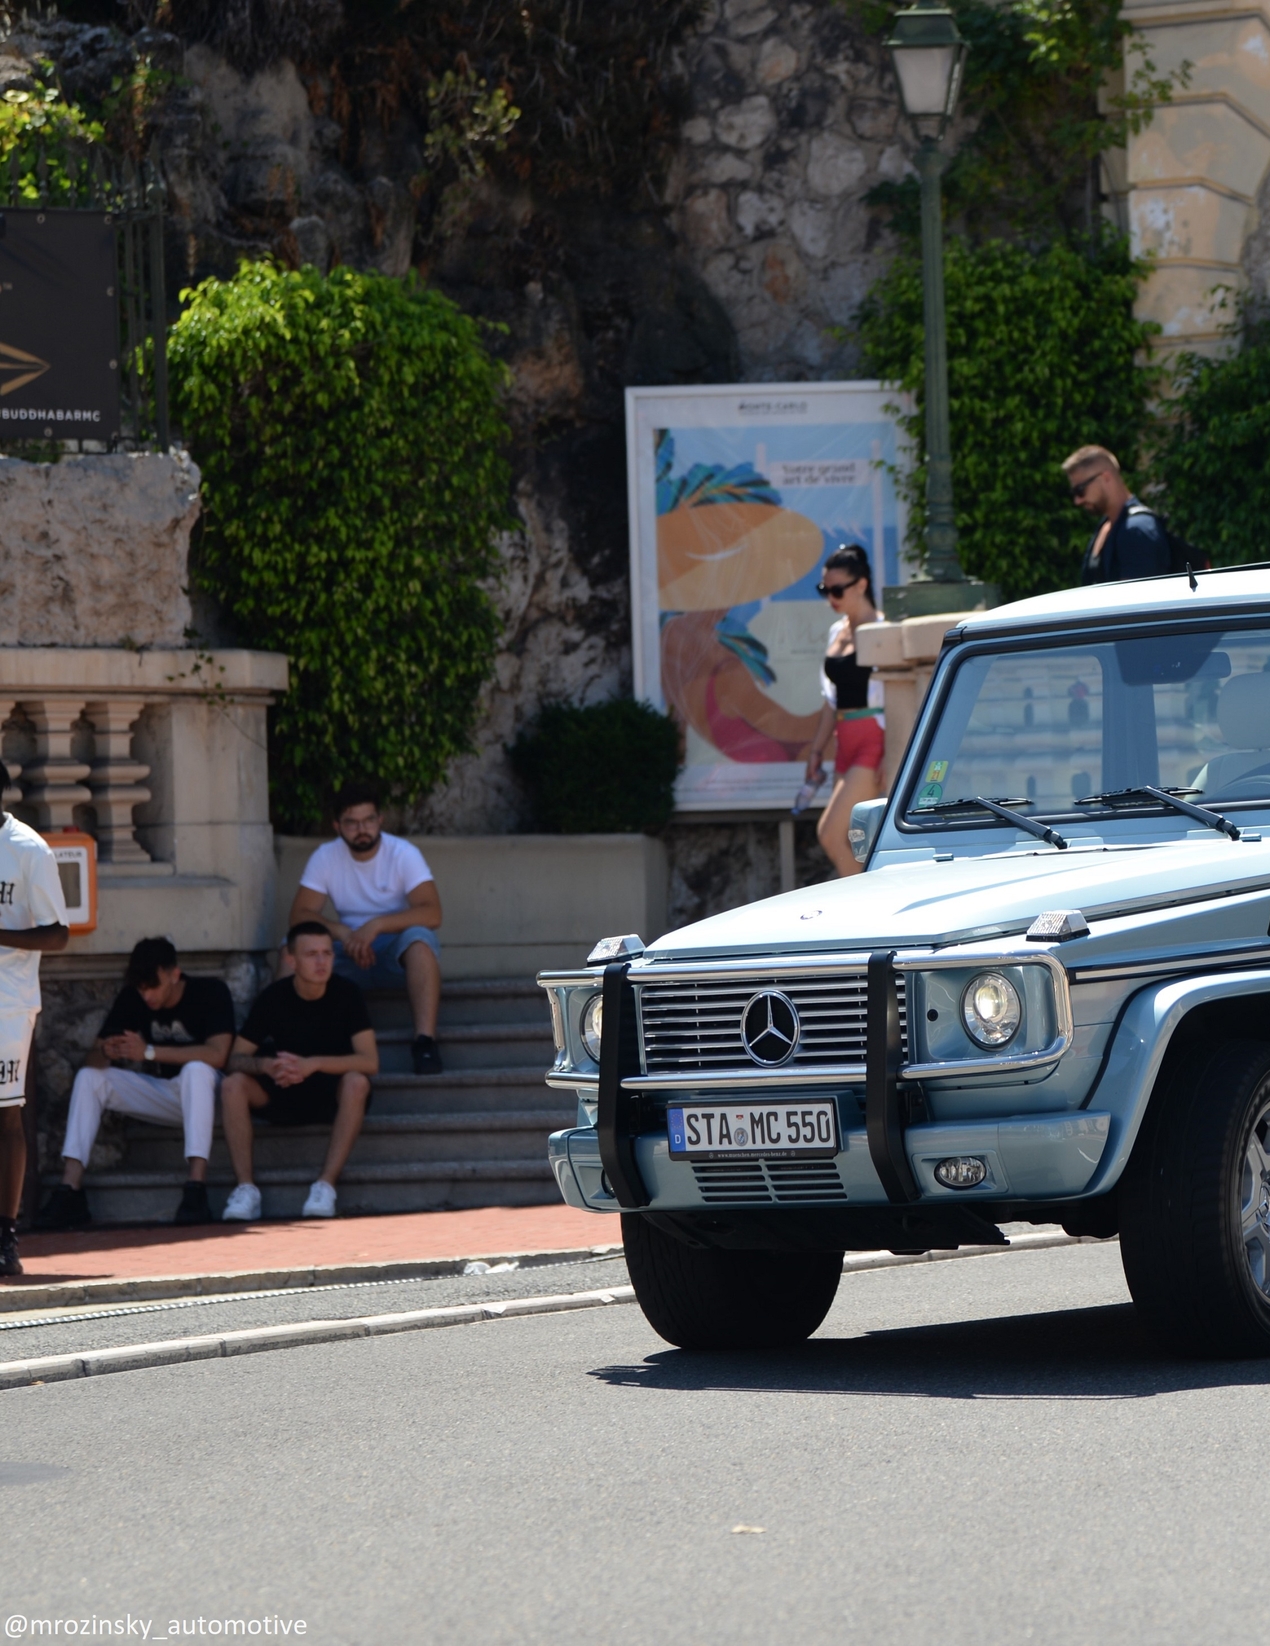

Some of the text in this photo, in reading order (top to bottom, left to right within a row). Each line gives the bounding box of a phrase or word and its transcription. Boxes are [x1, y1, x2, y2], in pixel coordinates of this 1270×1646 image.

[0, 408, 101, 422] BUDDHABARMC
[686, 1110, 831, 1146] STA MC 550
[674, 1134, 682, 1144] D
